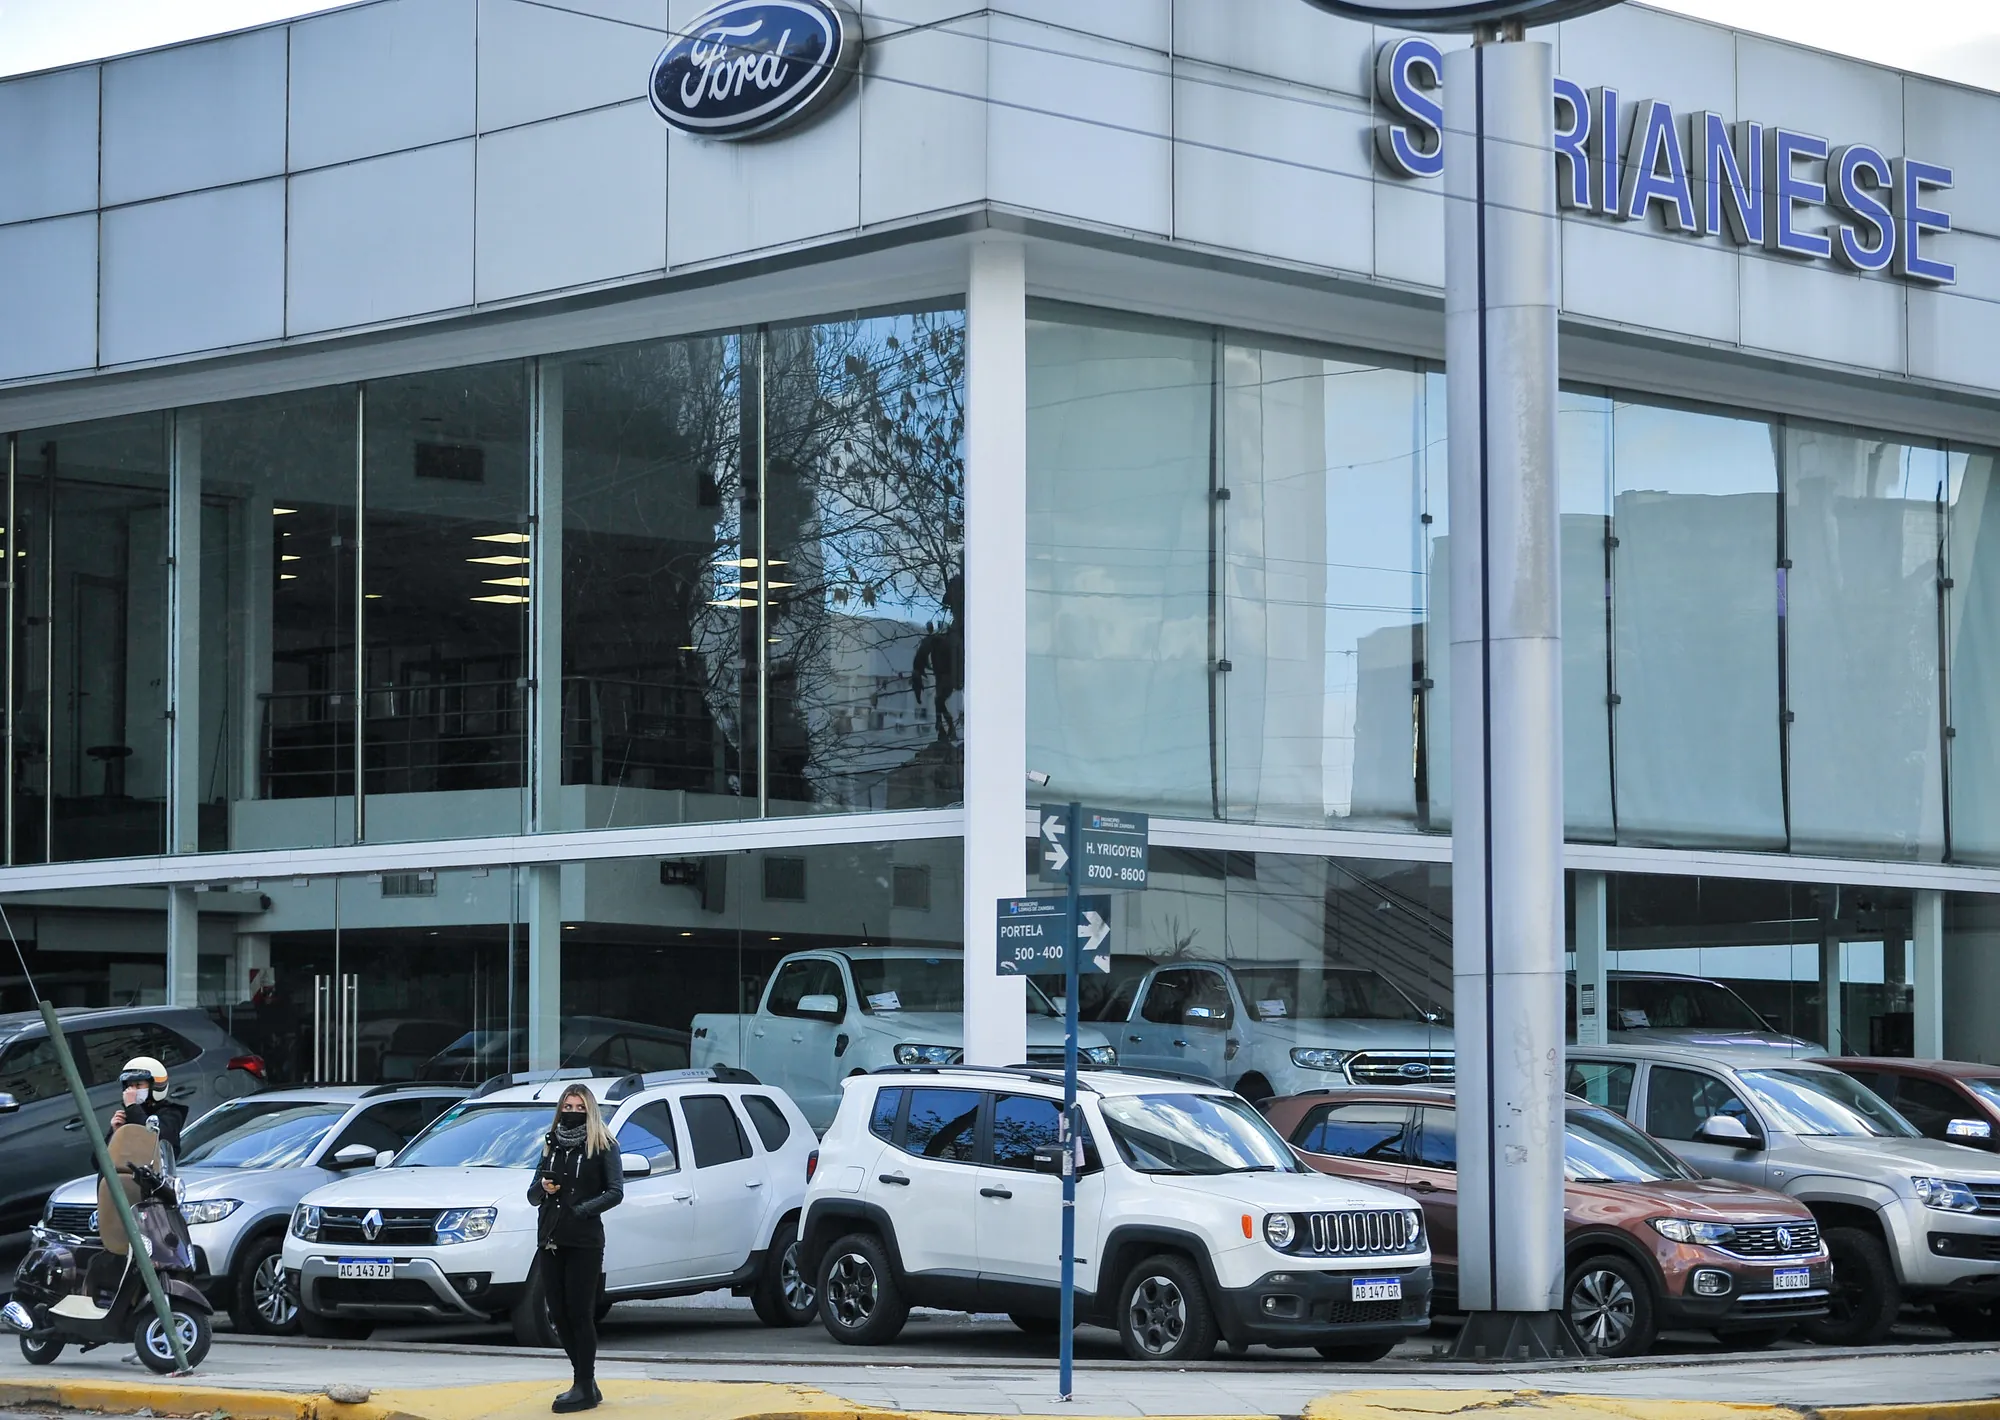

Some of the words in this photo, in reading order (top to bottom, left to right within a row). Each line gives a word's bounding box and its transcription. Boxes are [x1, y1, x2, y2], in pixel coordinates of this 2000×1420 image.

[681, 19, 792, 108] Ford
[1388, 36, 1958, 286] SRIANESE
[1086, 842, 1095, 854] H.
[1097, 843, 1143, 858] YRIGOYEN
[1088, 864, 1112, 879] 8700
[1120, 867, 1145, 882] 8600
[1001, 924, 1043, 938] PORTELA
[1015, 947, 1034, 960] 500
[1042, 945, 1063, 958] 400
[340, 1265, 352, 1277] AC
[356, 1265, 375, 1277] 143
[378, 1265, 391, 1277] ZP
[1355, 1286, 1366, 1299] AB
[1369, 1285, 1385, 1299] 147
[1387, 1285, 1400, 1298] GR
